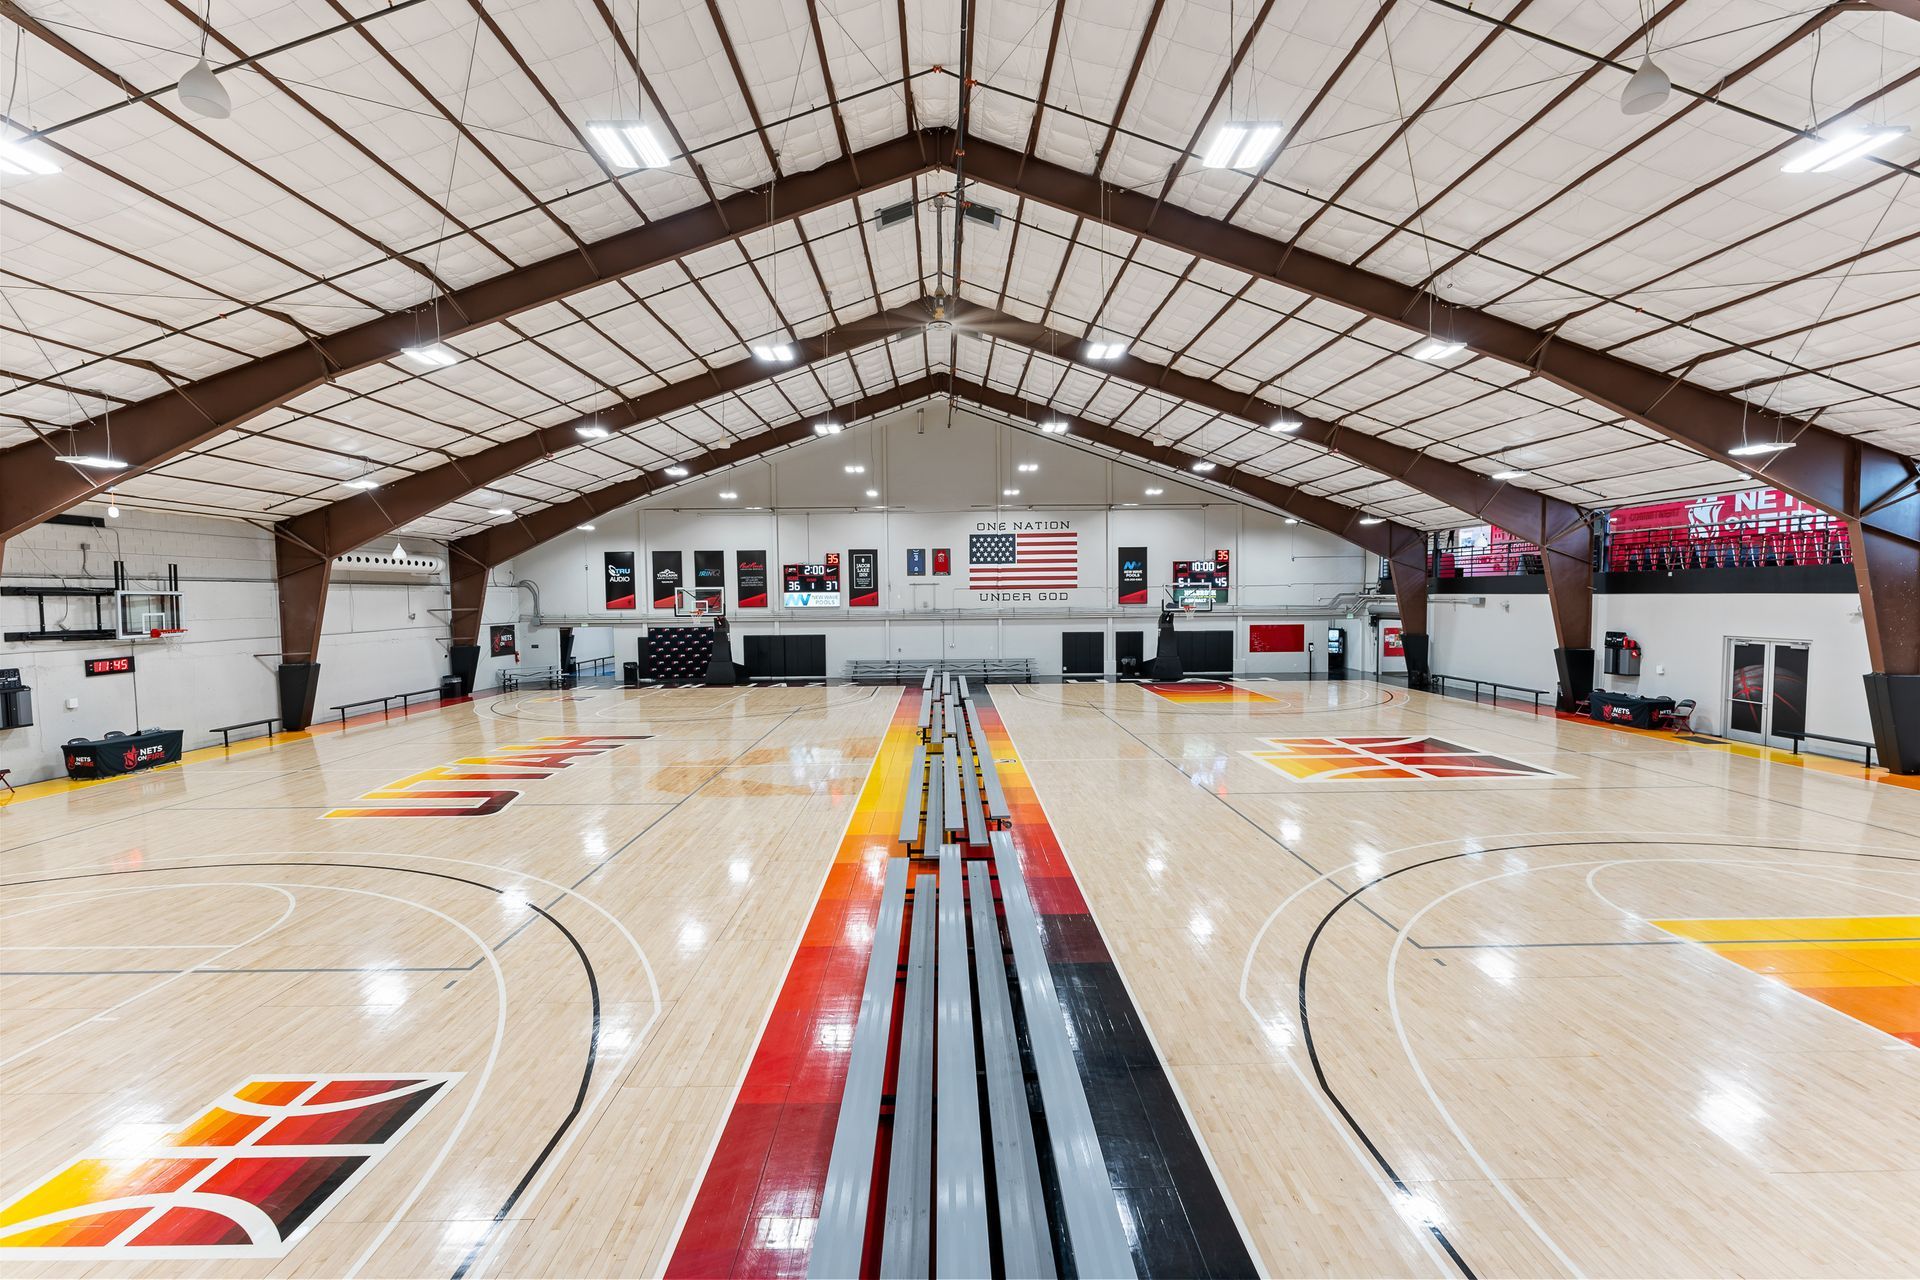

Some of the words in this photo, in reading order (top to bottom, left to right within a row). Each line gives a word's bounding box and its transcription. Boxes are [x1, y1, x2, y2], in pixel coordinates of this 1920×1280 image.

[976, 522, 1006, 531] ONE
[1013, 520, 1070, 530] NATION
[1725, 513, 1756, 532] ON
[1758, 508, 1838, 534] FIRE
[827, 554, 838, 564] 35
[1217, 550, 1228, 560] 35
[804, 565, 825, 575] 2:00
[1192, 562, 1214, 571] 10:00
[788, 581, 800, 591] 36
[826, 581, 838, 590] 37
[1215, 577, 1227, 587] 45
[980, 592, 1032, 602] UNDER
[1038, 592, 1069, 601] GOD
[98, 659, 128, 671] 11:45
[1612, 707, 1630, 715] NETS
[140, 745, 163, 755] NETS
[146, 751, 165, 761] FIRE
[317, 733, 660, 819] UTAH
